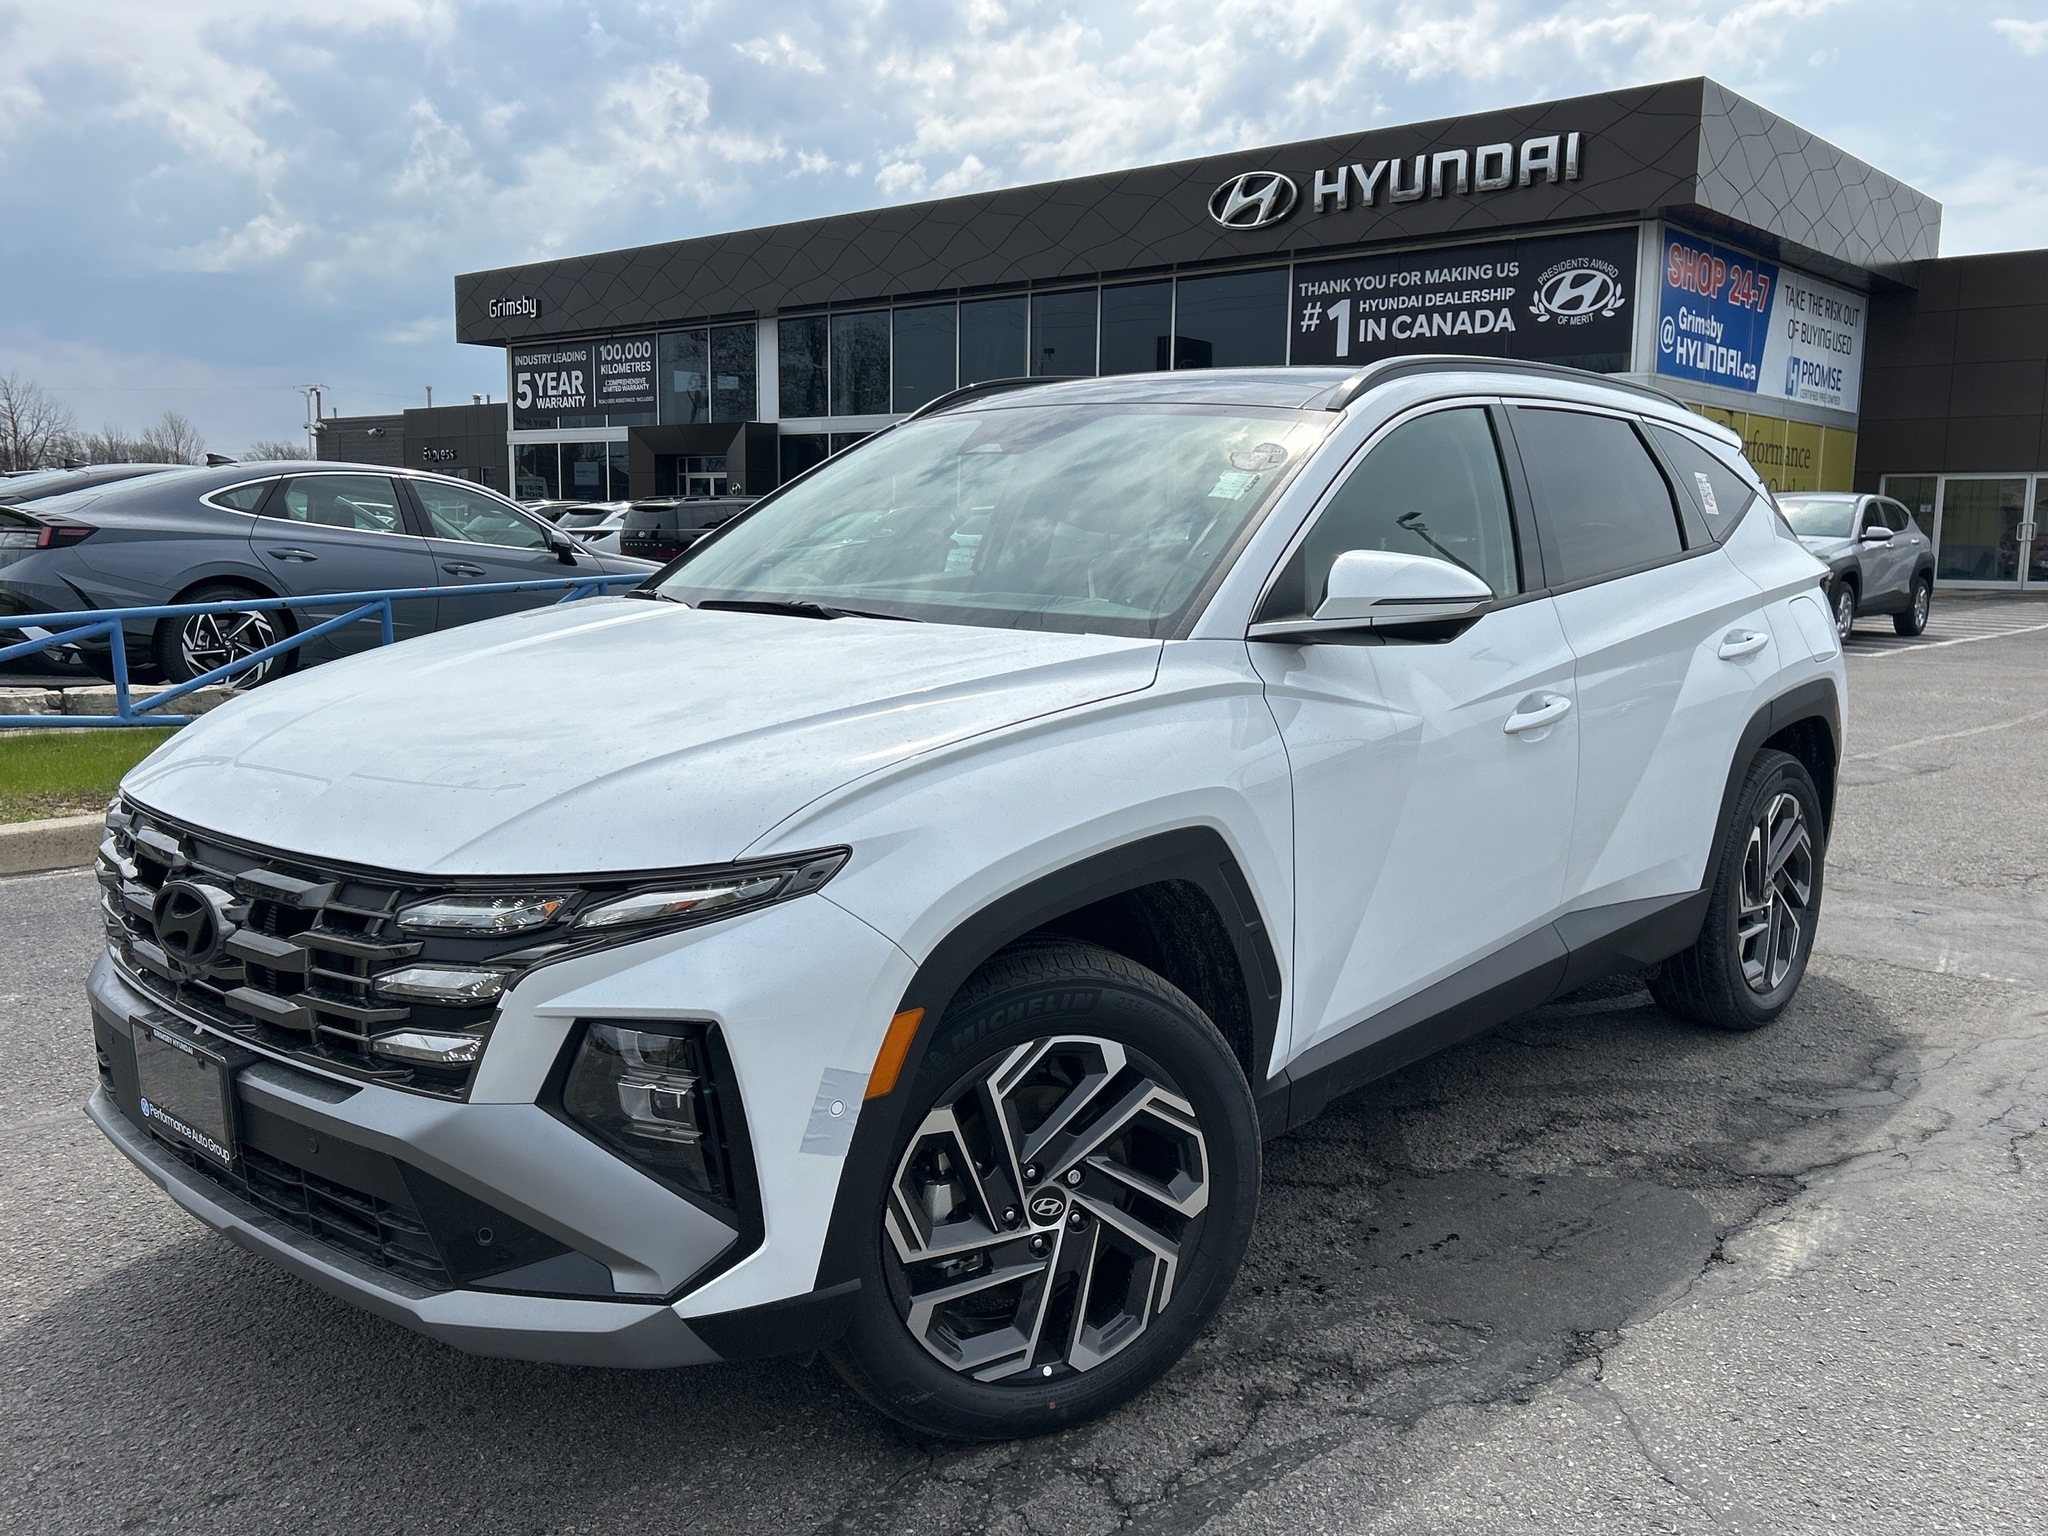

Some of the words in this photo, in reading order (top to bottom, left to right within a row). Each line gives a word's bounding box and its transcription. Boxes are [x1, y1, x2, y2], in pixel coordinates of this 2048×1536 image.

[1313, 132, 1582, 213] HYUNDAI
[1299, 278, 1351, 297] THANK
[1354, 275, 1386, 291] YOU
[1389, 271, 1421, 288] FOR
[1424, 264, 1493, 284] MAKING
[1496, 262, 1519, 278] US
[1590, 258, 1619, 279] AWARD
[1667, 242, 1726, 299] SHOP
[488, 295, 538, 319] Grimsby
[1359, 294, 1422, 313] HYUNDAI
[1425, 287, 1516, 307] DEALERSHIP
[1785, 285, 1806, 312] TAKE
[1808, 293, 1824, 317] THE
[1825, 298, 1843, 322] RISK
[1844, 305, 1860, 328] OUT
[1300, 299, 1351, 357] #1
[1359, 317, 1387, 342] IN
[1391, 307, 1516, 340] CANADA
[1557, 315, 1569, 325] OF
[1569, 312, 1594, 326] MERIT
[1678, 306, 1723, 344] Grimsby
[600, 341, 652, 362] 100,000
[1787, 319, 1800, 340] OF
[1800, 322, 1832, 350] BUYING
[1832, 332, 1852, 356] USED
[515, 353, 552, 366] INDUSTRY
[553, 350, 587, 363] LEADING
[600, 360, 652, 375] KILOMETRES
[516, 372, 533, 409] 5
[534, 370, 585, 396] YEAR
[622, 383, 650, 392] WARRANTY
[1801, 360, 1843, 392] PROMISE
[536, 395, 586, 409] WARRANTY
[422, 446, 455, 463] Express
[1731, 427, 1812, 470] rformance
[951, 990, 1095, 1054] MICHELIN
[149, 1103, 192, 1138] Performance
[191, 1128, 208, 1148] Auto
[207, 1138, 230, 1164] Group
